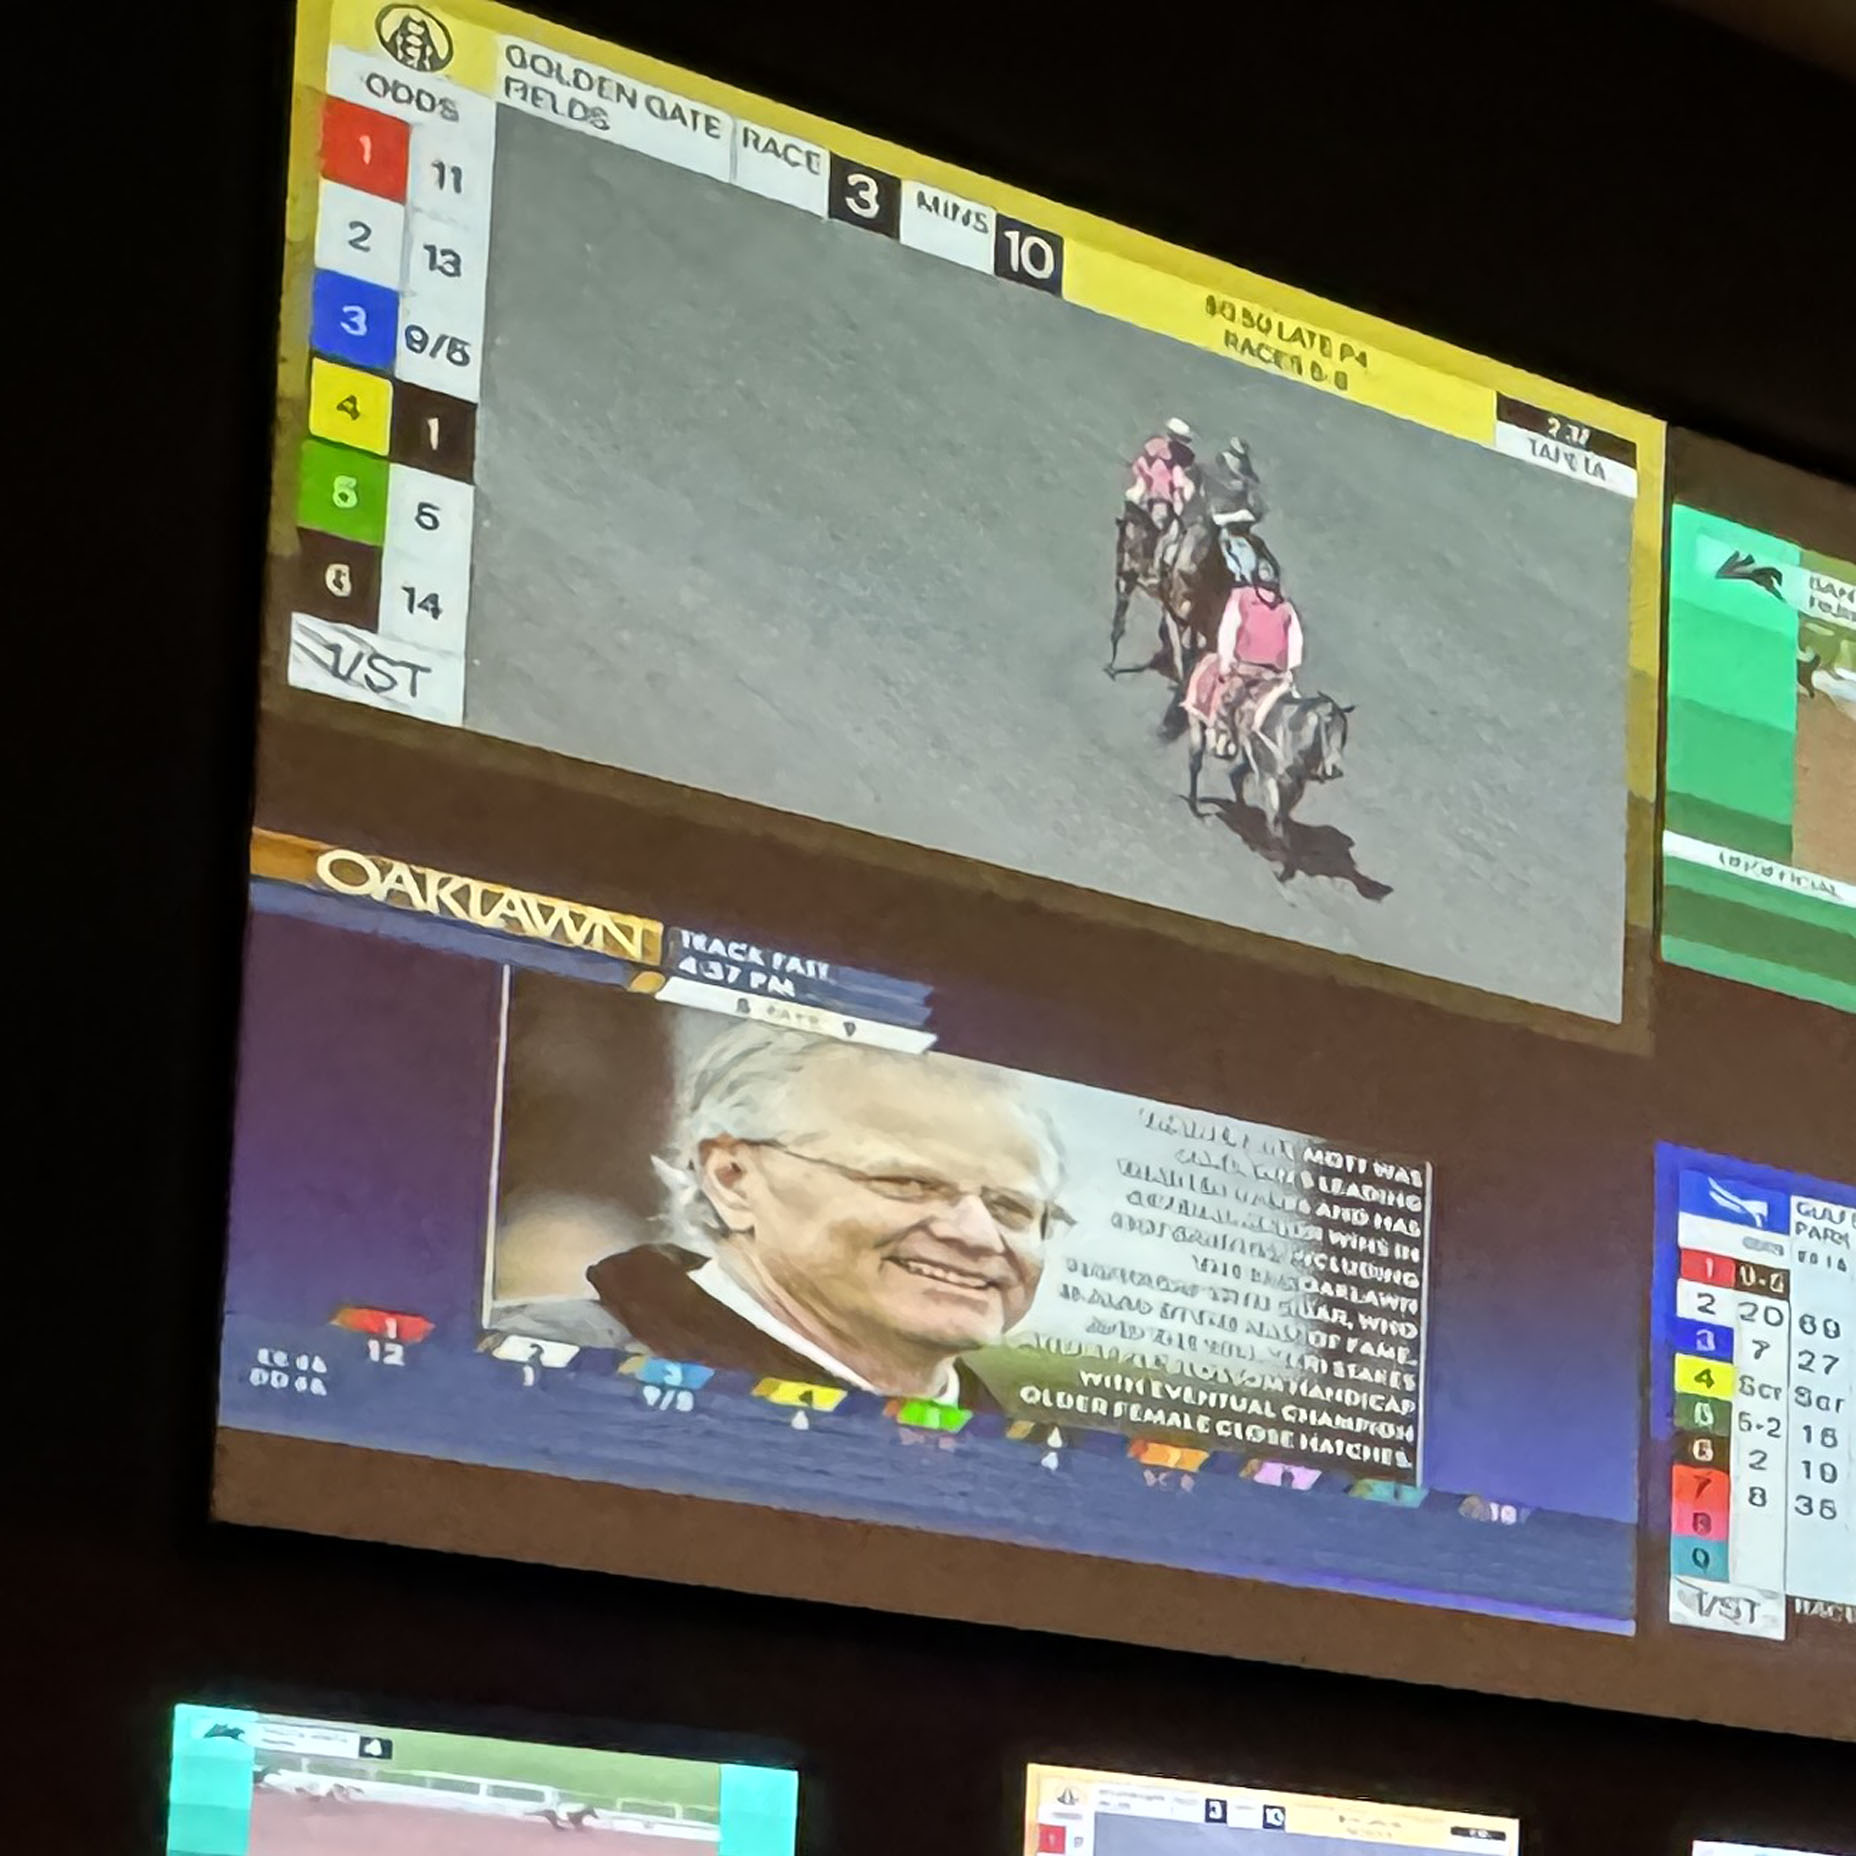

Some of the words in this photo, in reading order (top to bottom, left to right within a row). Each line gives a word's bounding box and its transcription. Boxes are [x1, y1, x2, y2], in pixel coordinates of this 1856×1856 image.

[365, 72, 460, 122] ODDS
[504, 44, 638, 109] GOLDEN
[645, 94, 721, 140] GATE
[504, 76, 611, 131] FIELDS
[431, 161, 462, 194] 11
[742, 126, 821, 175] RACE
[845, 174, 880, 218] 3
[916, 191, 989, 235] MINS
[1002, 229, 1054, 281] 10
[348, 222, 372, 252] 2
[423, 242, 462, 279] 13
[341, 305, 368, 336] 3
[336, 394, 361, 420] 4
[401, 585, 442, 621] 14
[315, 849, 645, 960] OAKLAWN
[1697, 1293, 1716, 1315] 2
[1738, 1301, 1785, 1328] 20
[367, 1339, 406, 1367] 12
[1796, 1350, 1839, 1376] 27
[1694, 1368, 1716, 1389] 4
[1748, 1450, 1768, 1470] 2
[1748, 1488, 1768, 1508] 8
